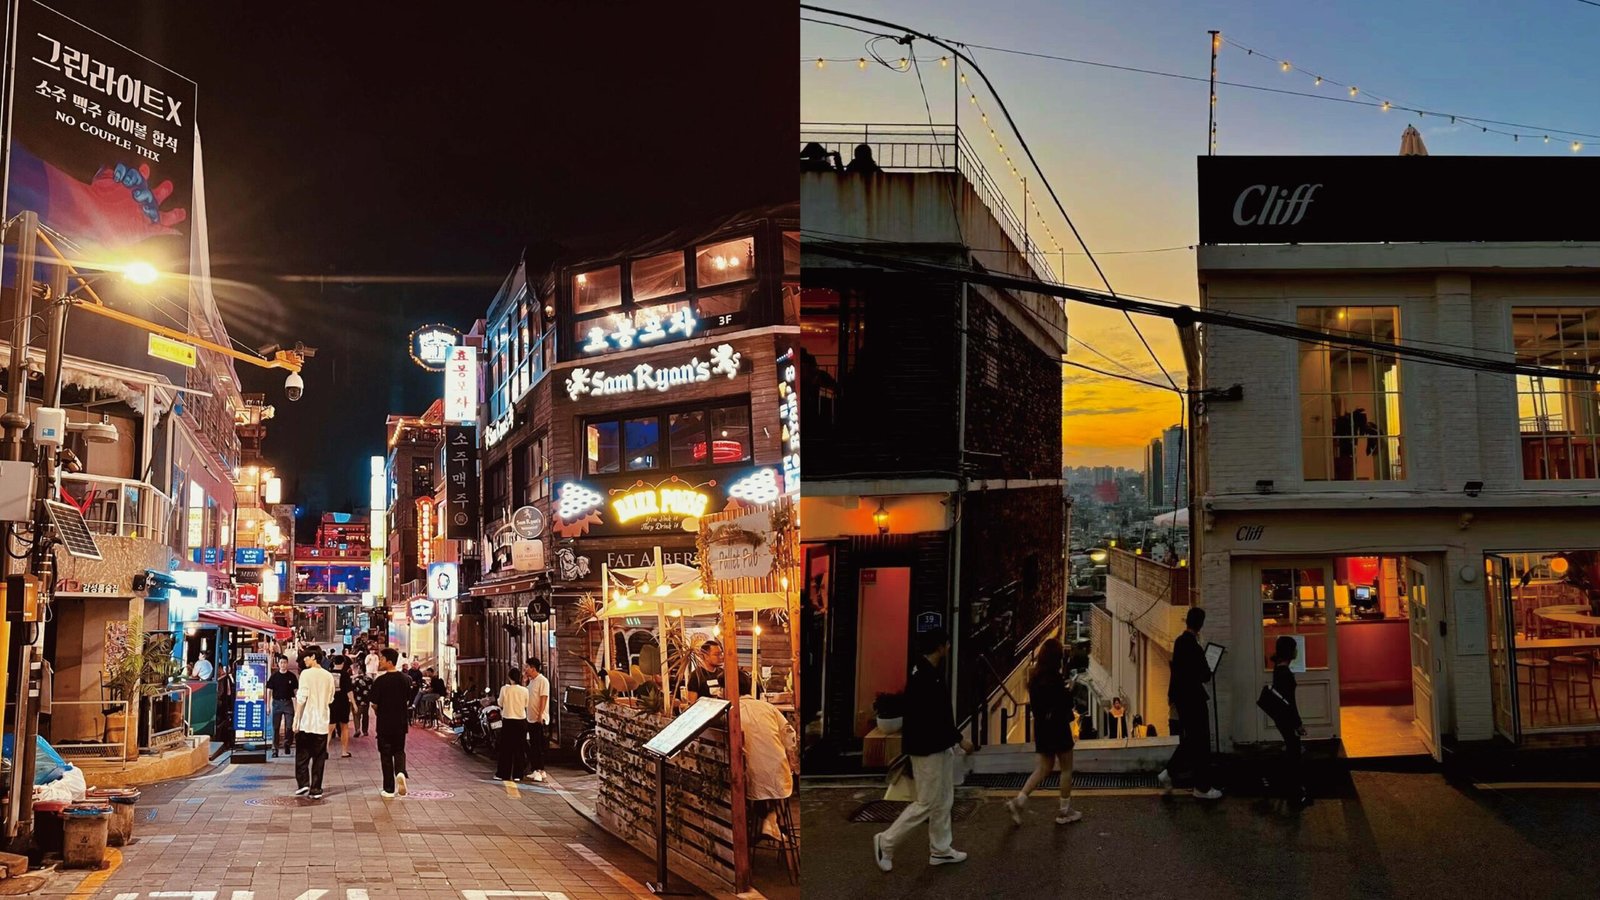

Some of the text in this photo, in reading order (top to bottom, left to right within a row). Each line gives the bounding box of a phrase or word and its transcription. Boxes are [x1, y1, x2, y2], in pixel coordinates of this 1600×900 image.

[32, 33, 182, 127] 그린라이트X
[35, 80, 178, 153] 소주 맥주 하이볼 합석
[55, 110, 160, 163] NO COUPLE THX
[1232, 183, 1323, 226] Cliff
[718, 315, 732, 326] 3F
[590, 357, 711, 396] Sam Ryan's
[1236, 524, 1265, 541] Cliff
[607, 552, 635, 567] FAT
[925, 615, 935, 623] 39
